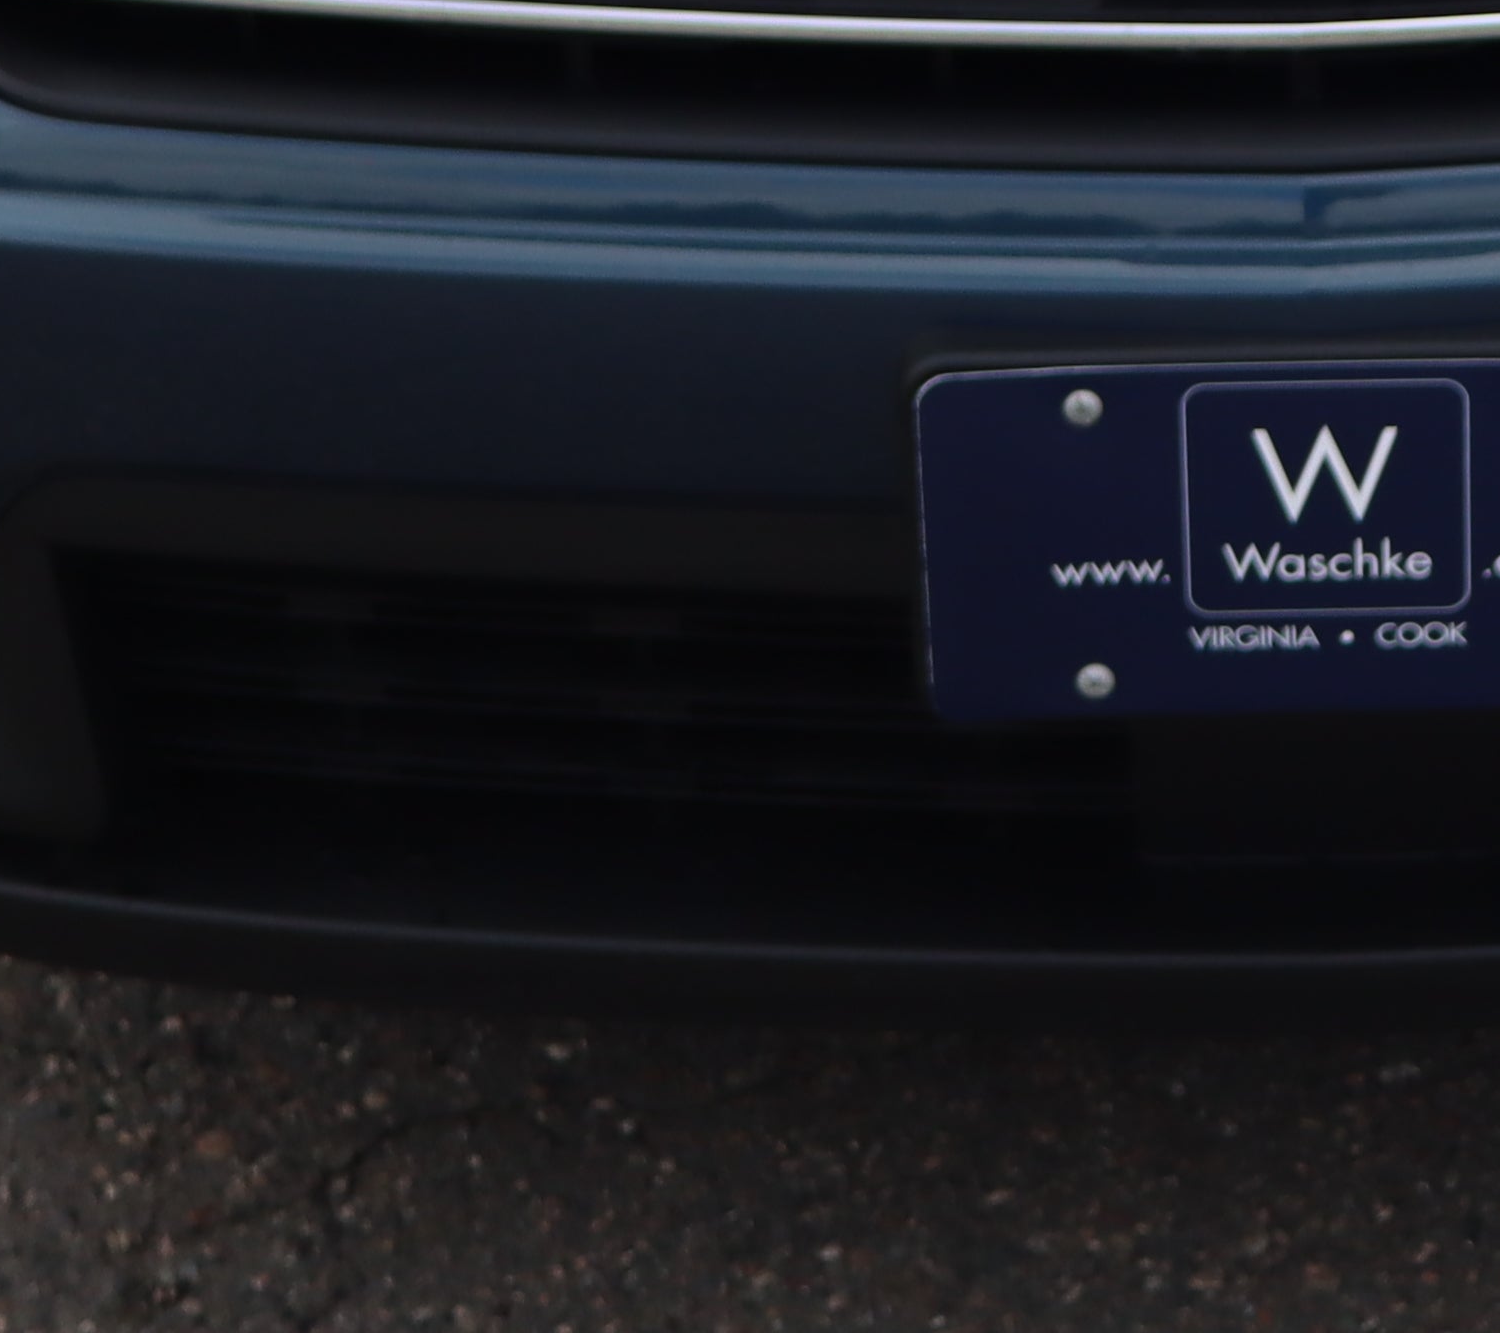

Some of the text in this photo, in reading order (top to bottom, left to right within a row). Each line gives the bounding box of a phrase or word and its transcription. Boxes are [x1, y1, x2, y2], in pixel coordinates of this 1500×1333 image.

[1250, 423, 1399, 524] W
[1050, 558, 1172, 588] www.
[1221, 536, 1434, 584] Waschke
[1188, 620, 1469, 652] VIRGINIA COOK
